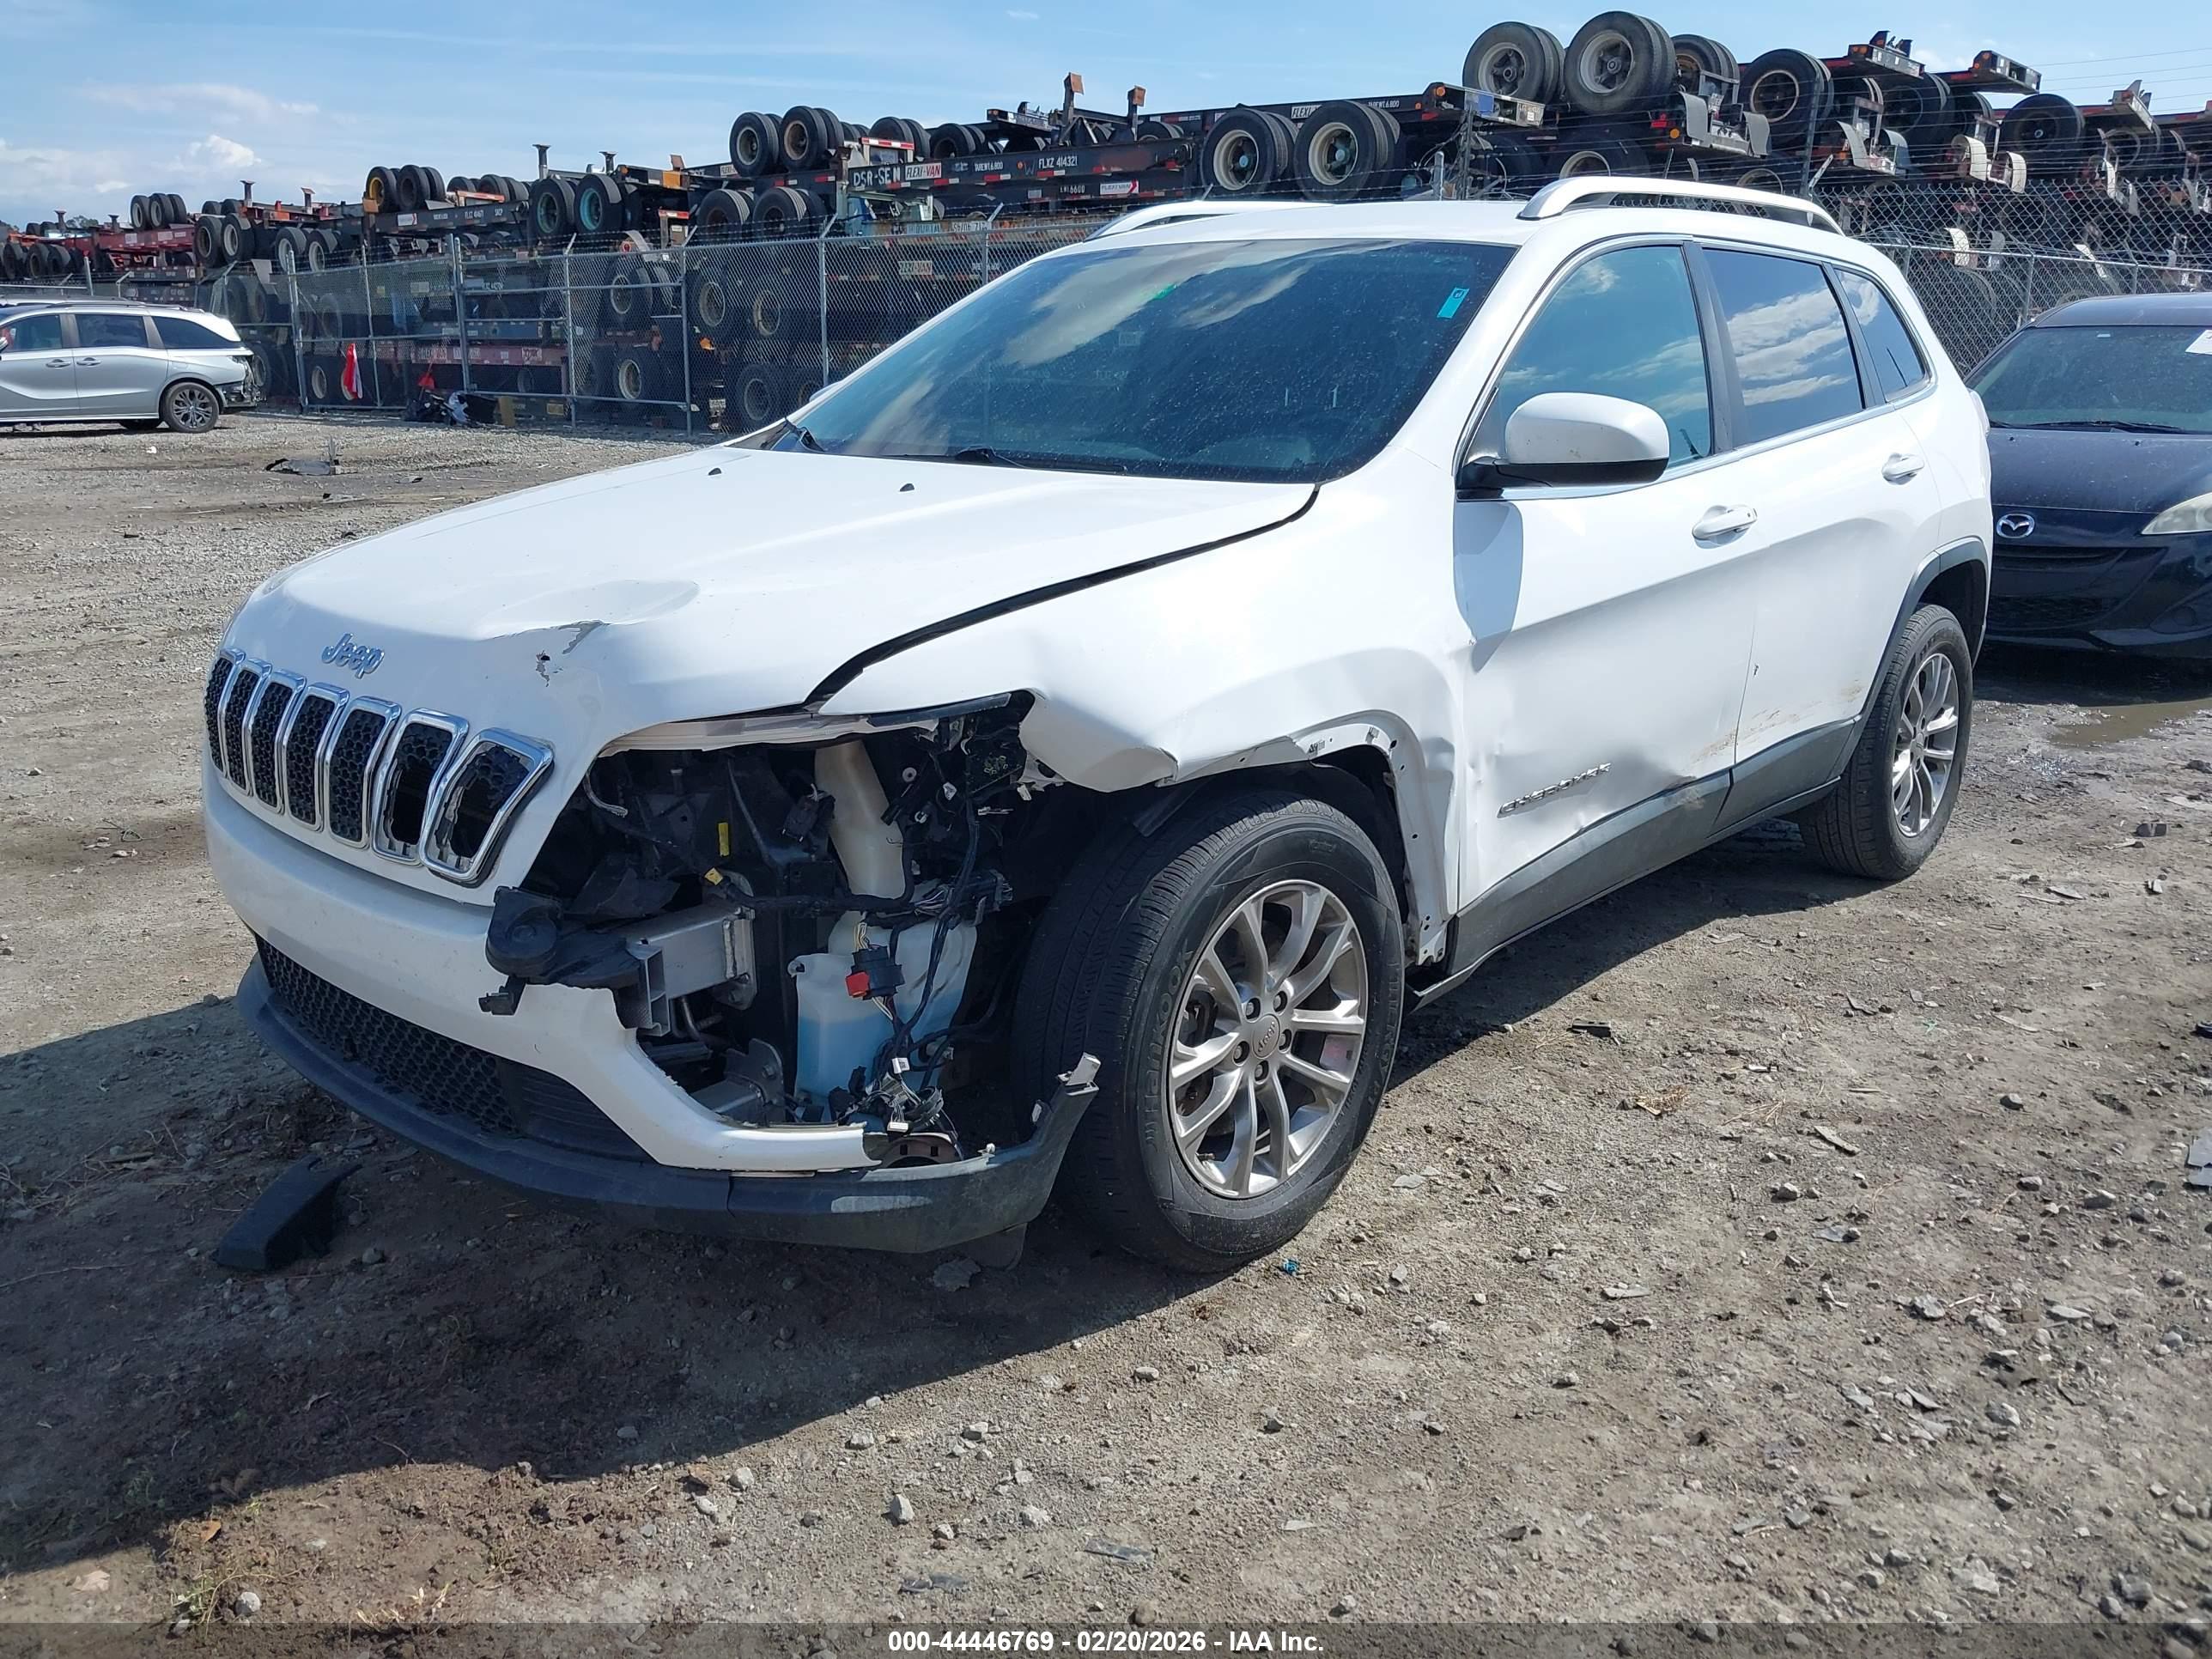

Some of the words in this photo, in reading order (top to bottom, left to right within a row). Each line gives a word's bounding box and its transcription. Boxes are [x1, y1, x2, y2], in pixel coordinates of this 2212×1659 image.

[1038, 158, 1054, 169] FLXZ
[1056, 155, 1078, 168] 414321
[906, 164, 941, 178] FLEXI-VAN
[321, 633, 385, 679] Jeep
